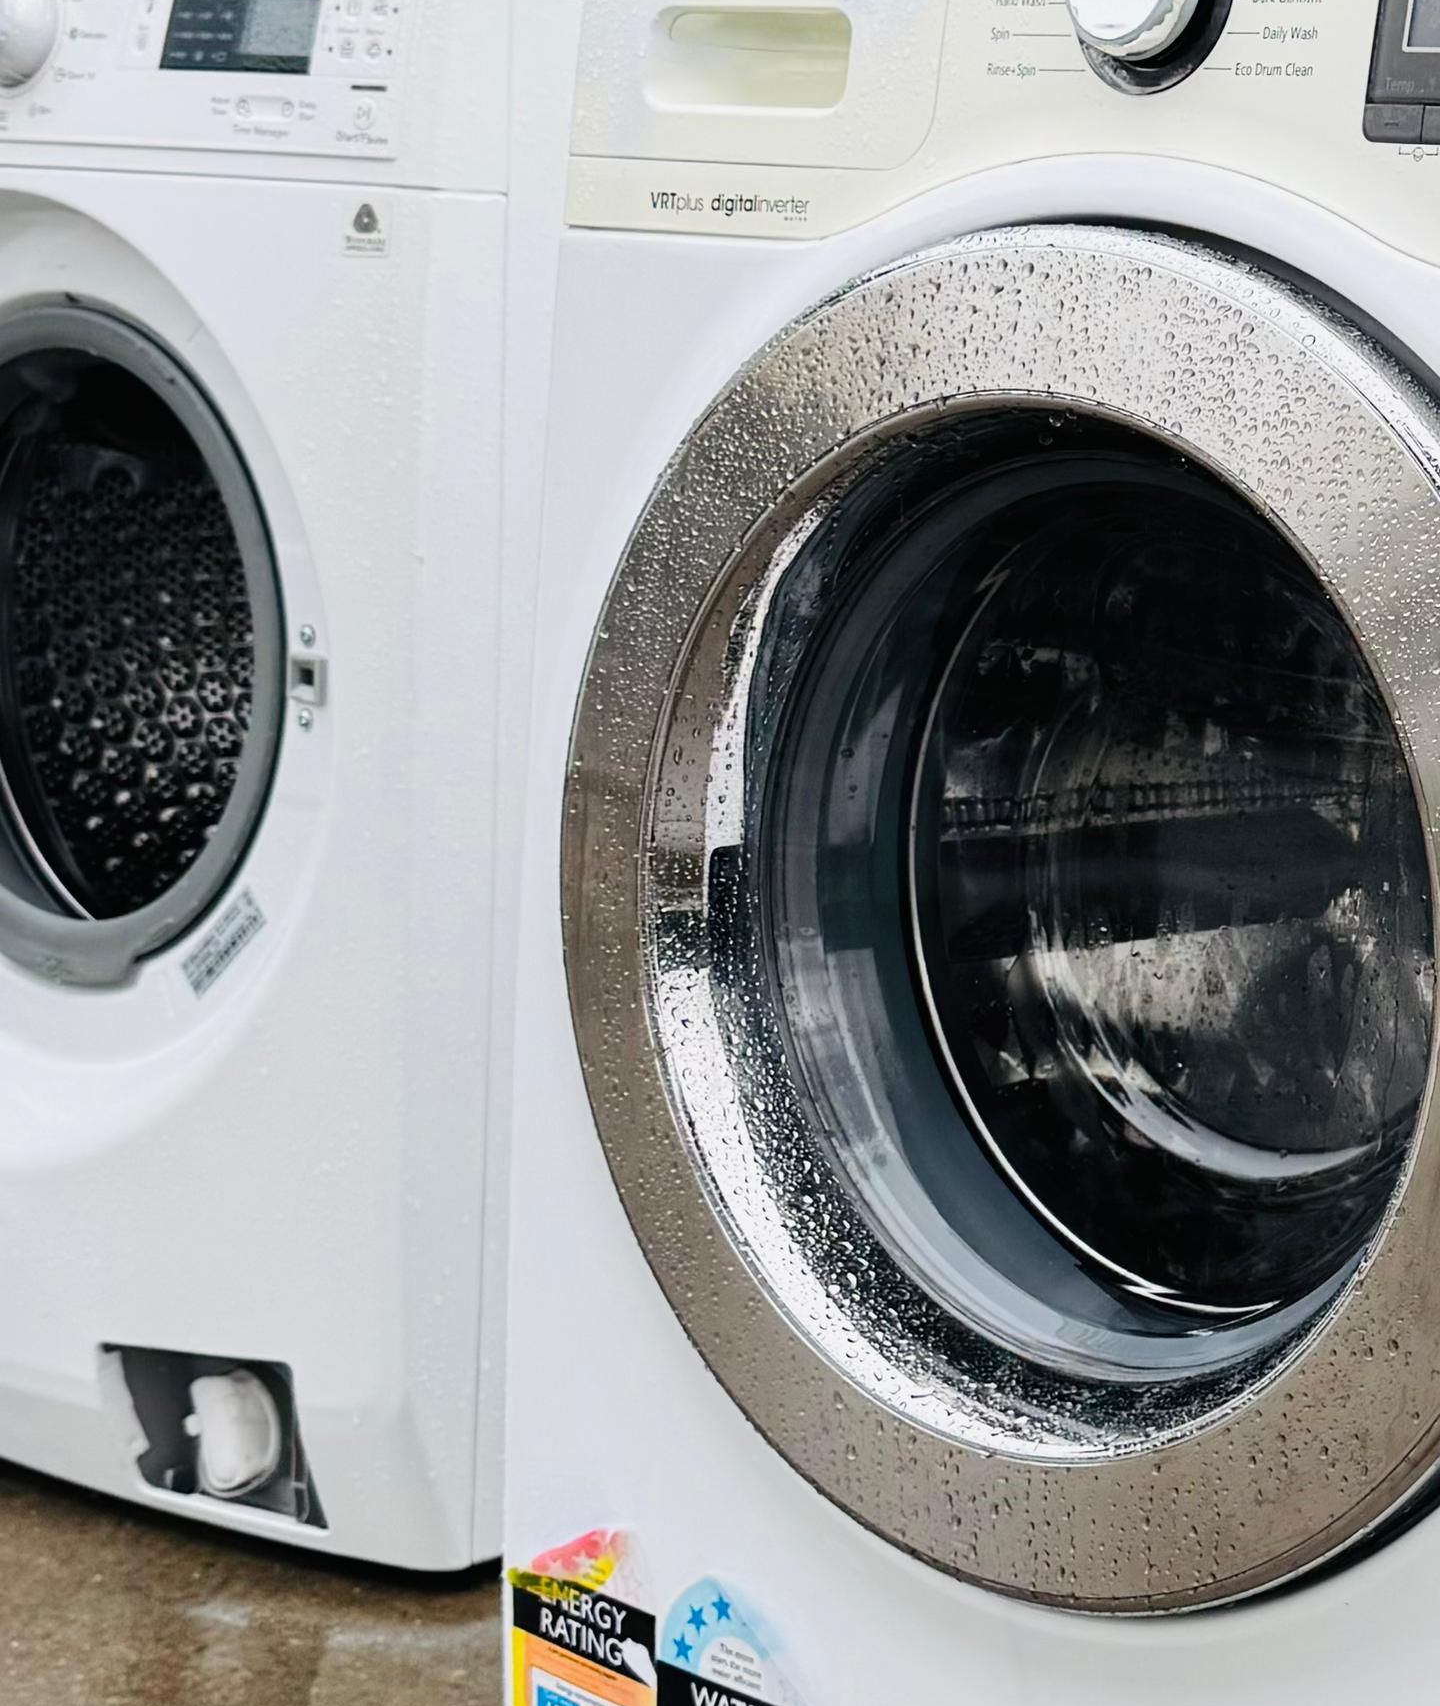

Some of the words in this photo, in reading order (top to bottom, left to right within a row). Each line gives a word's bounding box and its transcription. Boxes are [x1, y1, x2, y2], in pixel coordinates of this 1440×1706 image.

[991, 26, 1010, 44] Spin
[1262, 26, 1288, 44] Daily
[1290, 25, 1319, 40] Wash
[1235, 62, 1253, 77] Eco
[1255, 62, 1282, 77] Drum
[1285, 62, 1314, 77] Clean
[650, 191, 705, 215] VRTplus
[539, 1576, 627, 1635] ENERGY
[539, 1606, 623, 1667] RATING
